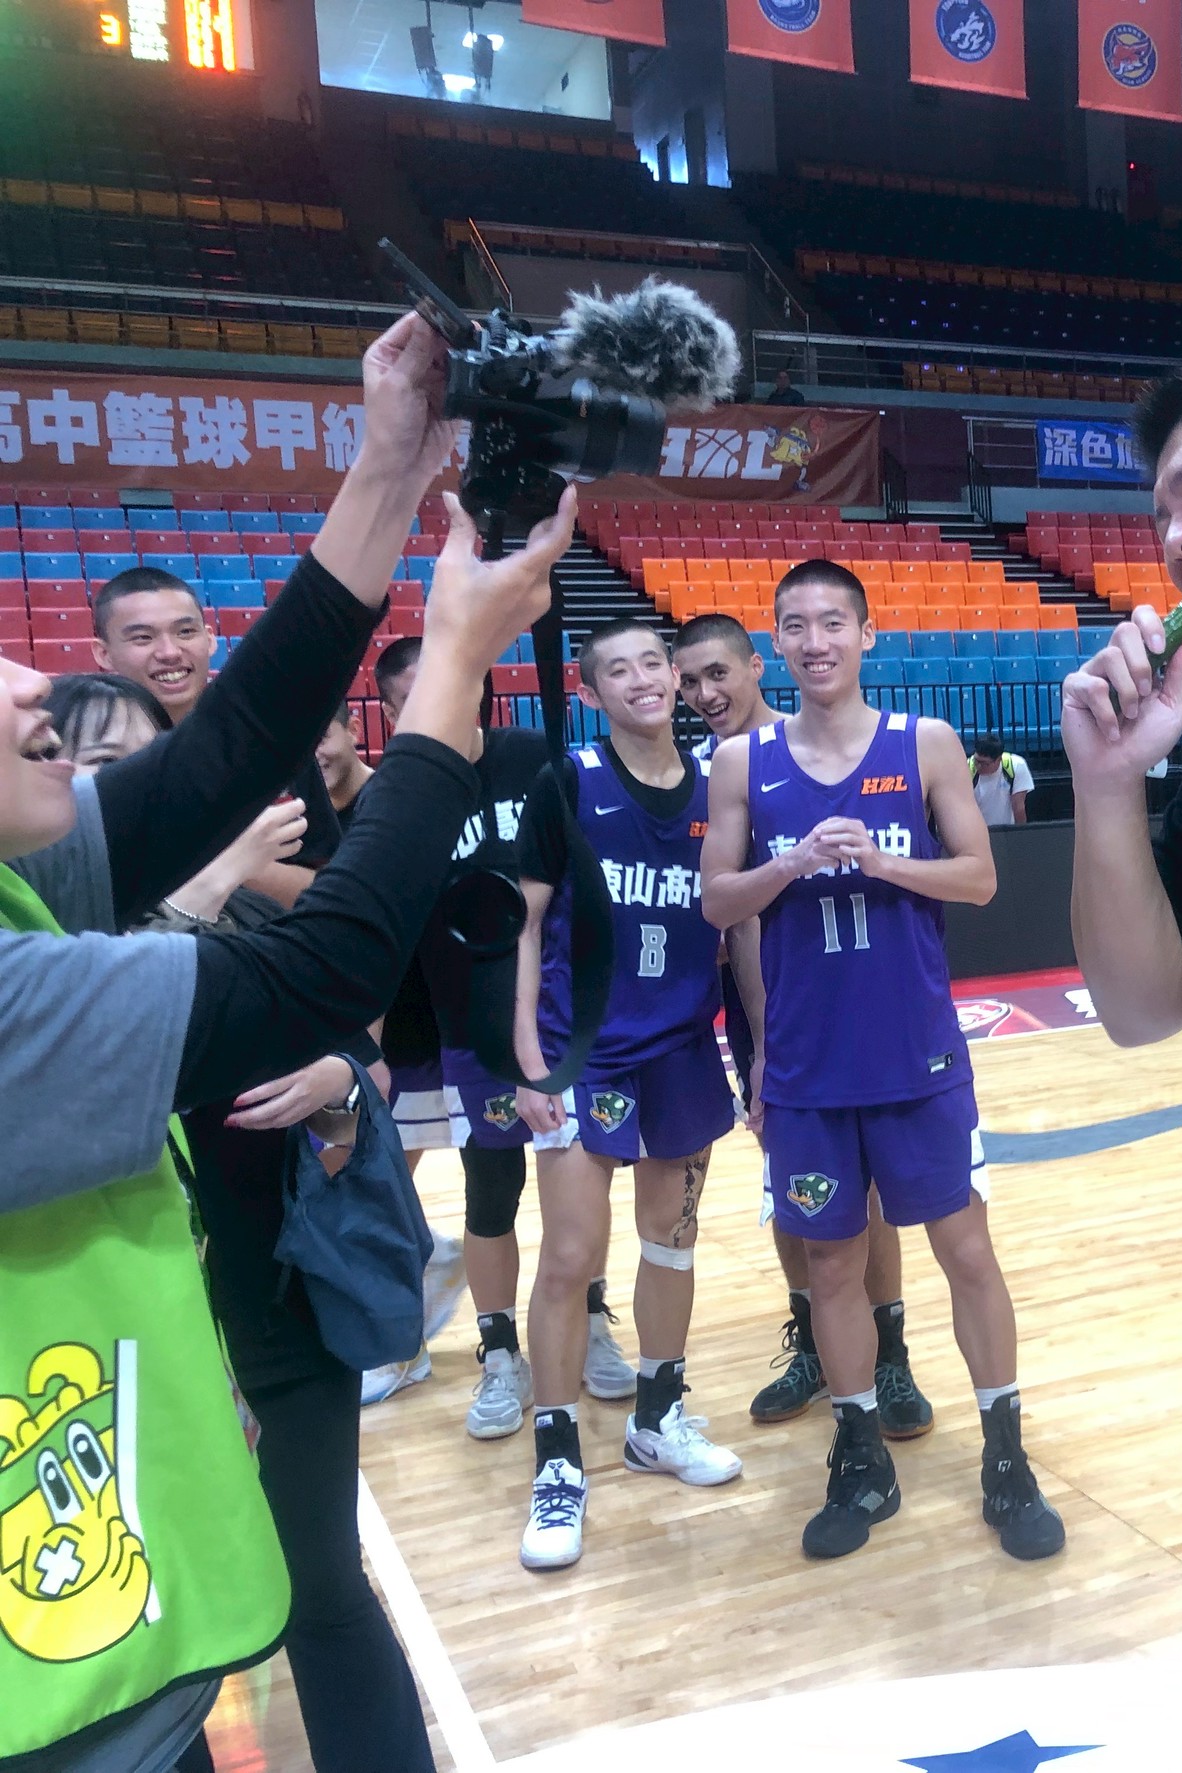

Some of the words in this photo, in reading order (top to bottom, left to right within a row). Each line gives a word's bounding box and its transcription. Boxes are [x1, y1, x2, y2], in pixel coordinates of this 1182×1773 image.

[861, 775, 908, 795] HBL
[600, 858, 702, 908] 東山高
[819, 892, 871, 954] 11
[637, 923, 667, 978] 8
